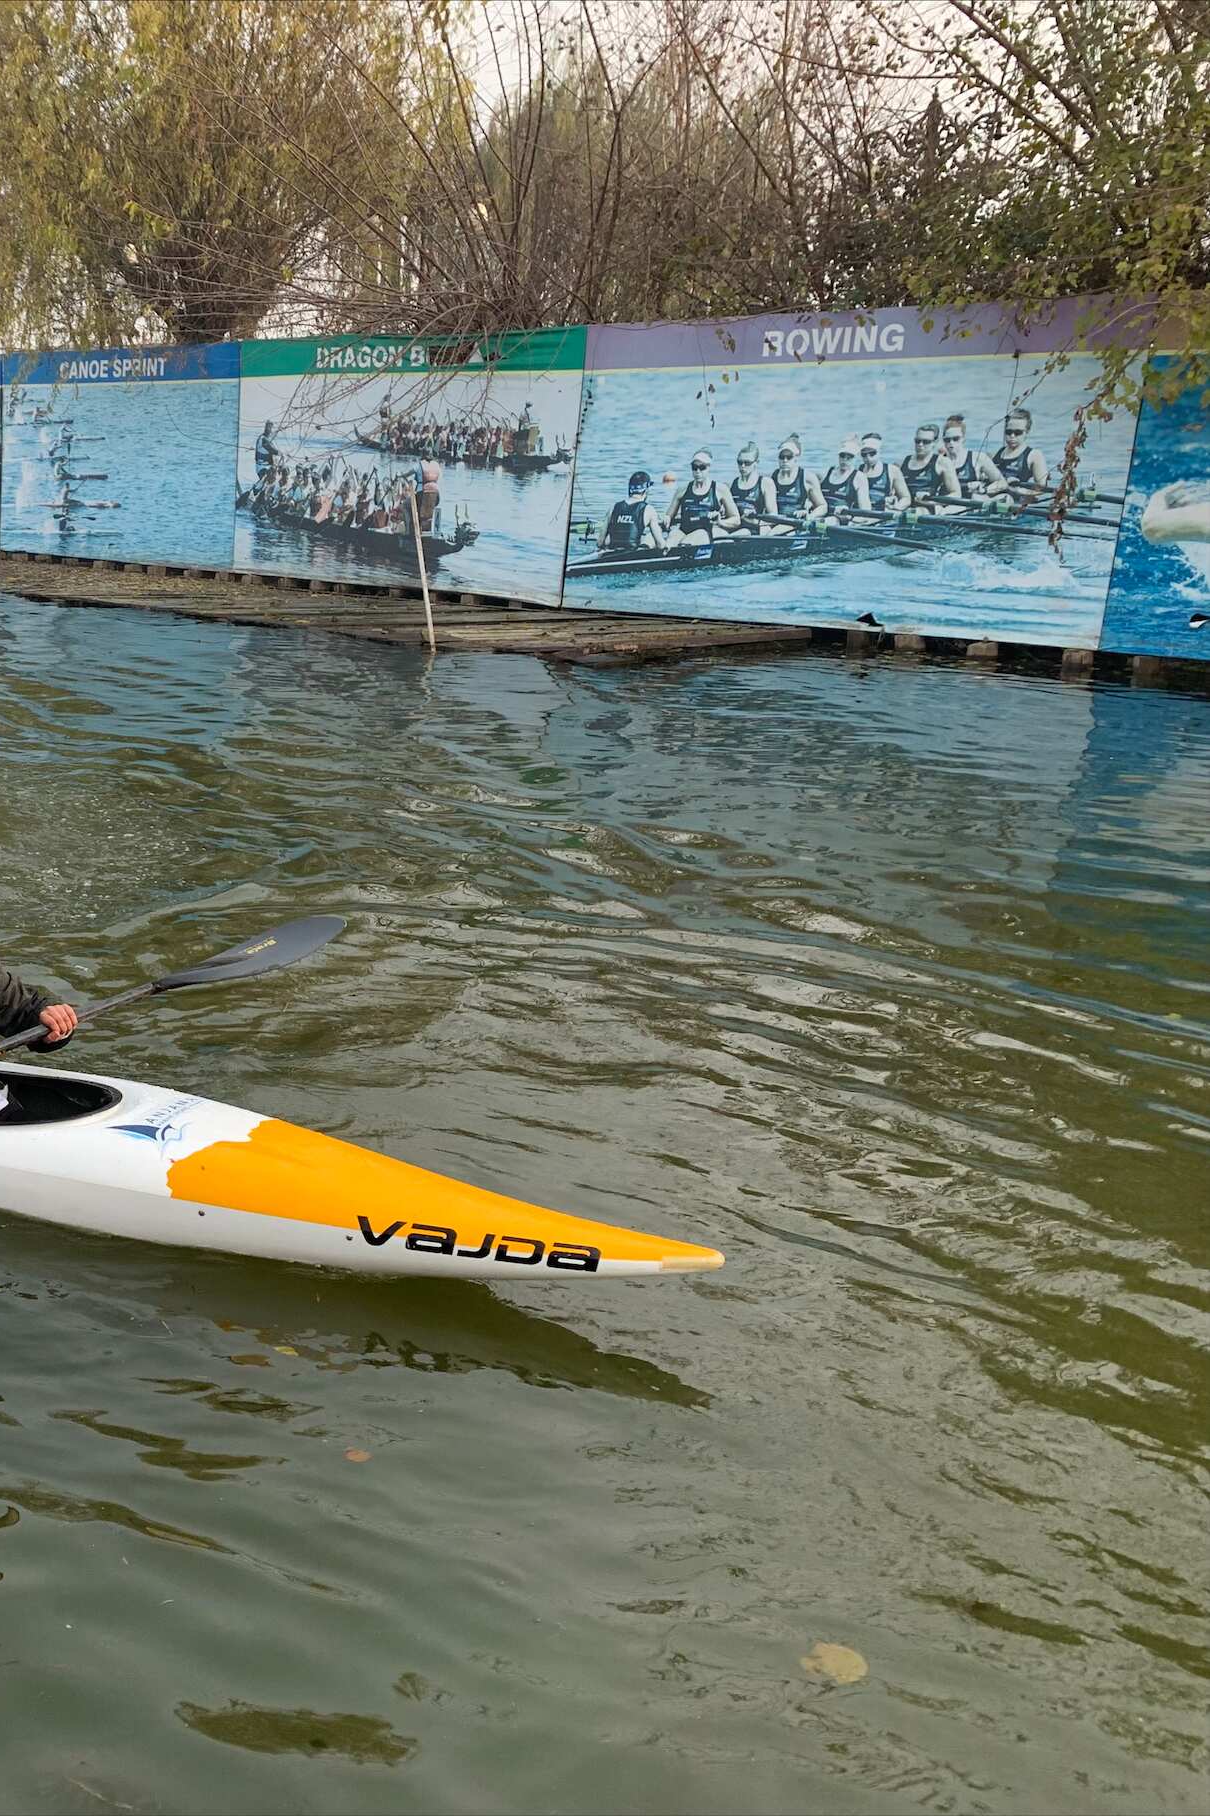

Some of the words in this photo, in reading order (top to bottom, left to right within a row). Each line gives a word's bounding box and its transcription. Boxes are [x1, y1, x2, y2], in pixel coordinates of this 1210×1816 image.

[762, 324, 905, 357] ROWING
[316, 345, 403, 368] DRAGON
[59, 360, 109, 379] CANOE
[113, 358, 166, 377] SPRINT
[617, 515, 634, 524] NZL
